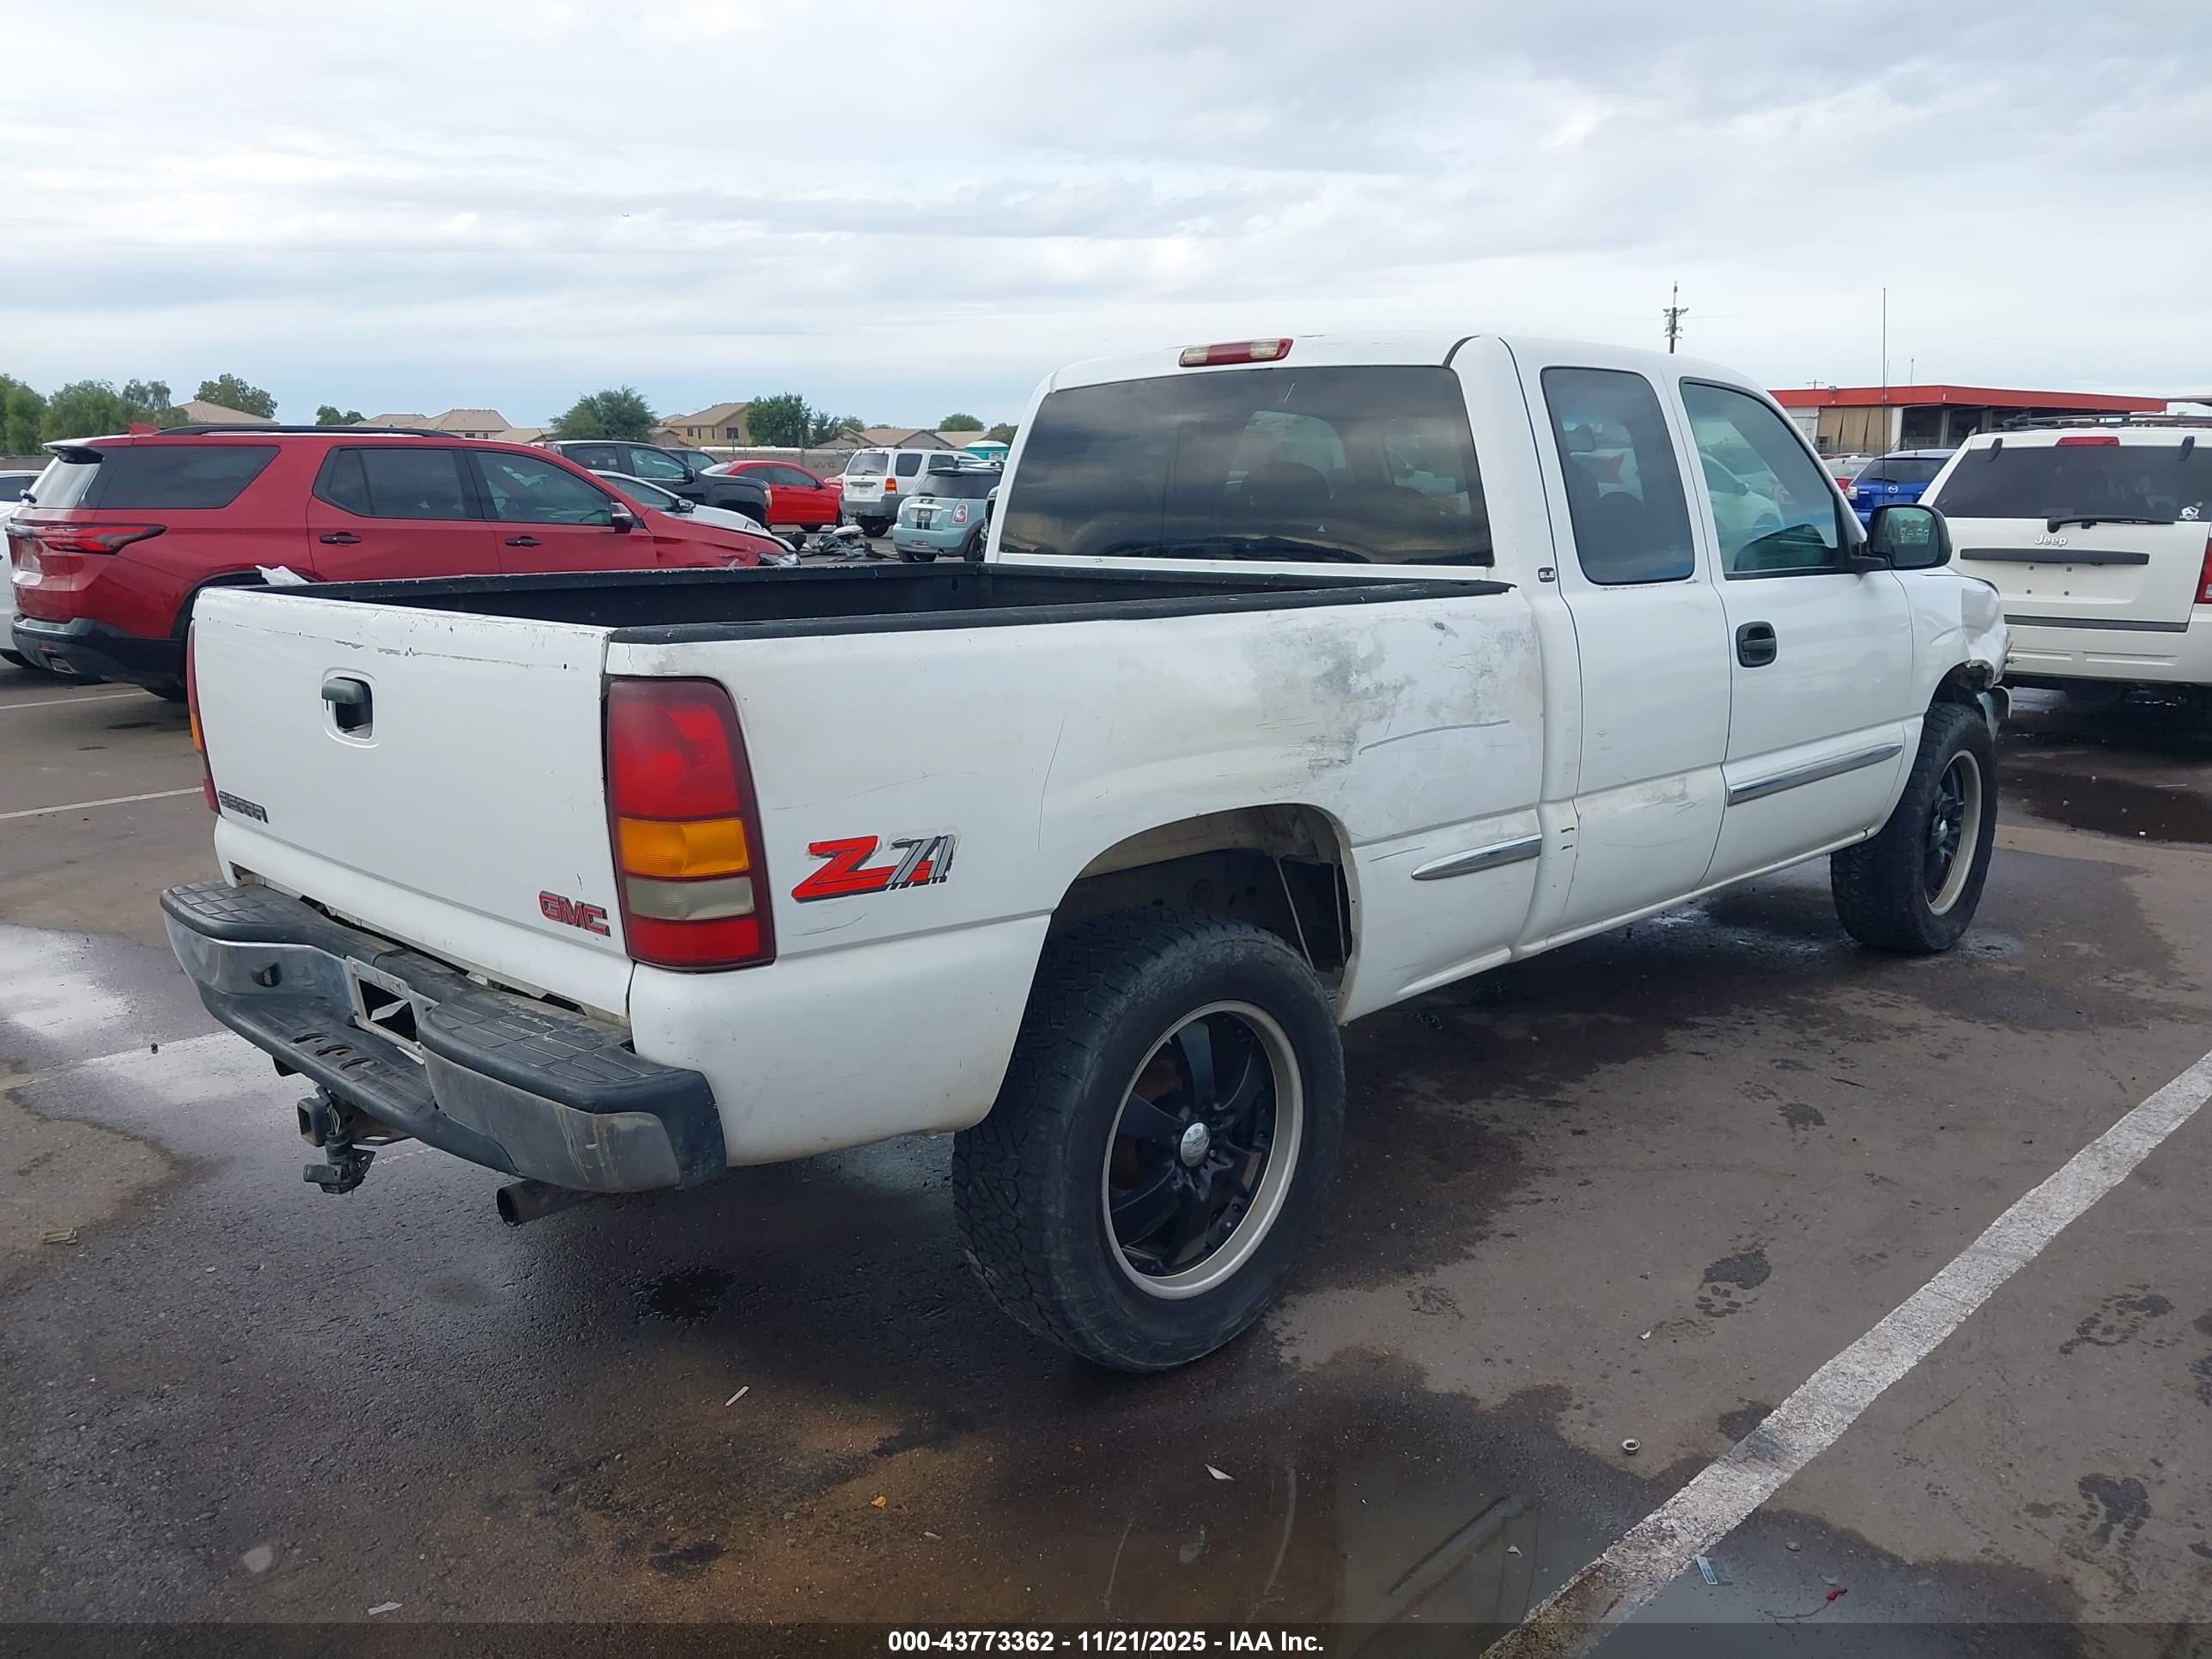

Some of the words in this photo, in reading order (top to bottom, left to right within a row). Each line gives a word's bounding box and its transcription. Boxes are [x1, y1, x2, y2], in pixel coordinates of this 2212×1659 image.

[2034, 533, 2068, 547] Jeep
[218, 790, 269, 823] SIERRA
[791, 835, 955, 903] Z71
[539, 890, 611, 937] GMC
